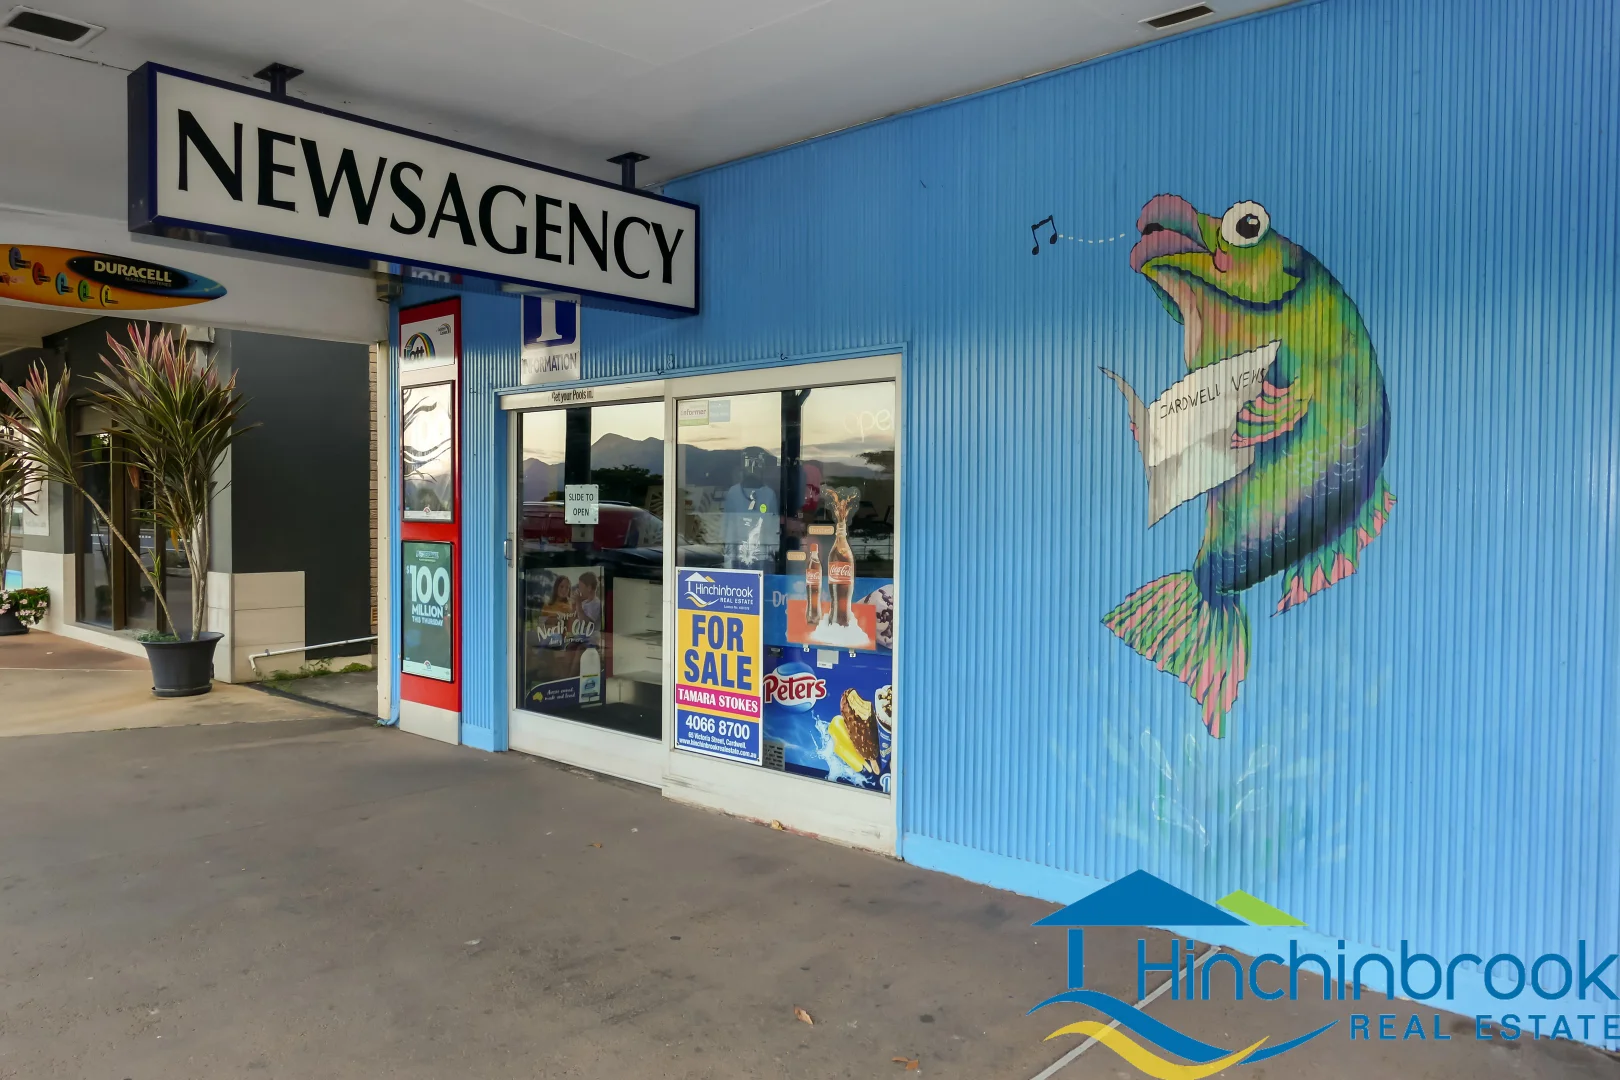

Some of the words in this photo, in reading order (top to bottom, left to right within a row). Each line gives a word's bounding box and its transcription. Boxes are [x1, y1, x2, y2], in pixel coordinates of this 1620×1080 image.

[177, 108, 684, 284] NEWSAGENCY
[93, 259, 172, 283] DURACELL
[522, 352, 577, 374] INFORMATION
[561, 391, 573, 403] your
[572, 389, 586, 400] Pools
[568, 492, 584, 502] SLIDE
[586, 493, 594, 502] TO
[572, 507, 590, 517] OPEN
[695, 583, 754, 598] Hinchinbrook
[411, 603, 444, 619] MILLION
[412, 616, 422, 624] THIS
[422, 616, 444, 627] THURSDAY
[536, 619, 567, 642] North
[571, 618, 595, 637] QLD
[691, 613, 745, 653] FOR
[683, 648, 752, 691] SALE
[763, 674, 827, 704] Peters
[677, 687, 717, 706] TAMARA
[718, 695, 759, 714] STOKES
[685, 714, 716, 734] 4066
[718, 720, 751, 741] 8700
[694, 732, 711, 742] Victoria
[678, 737, 758, 759] www.hinchinbrookrealestate.com.au
